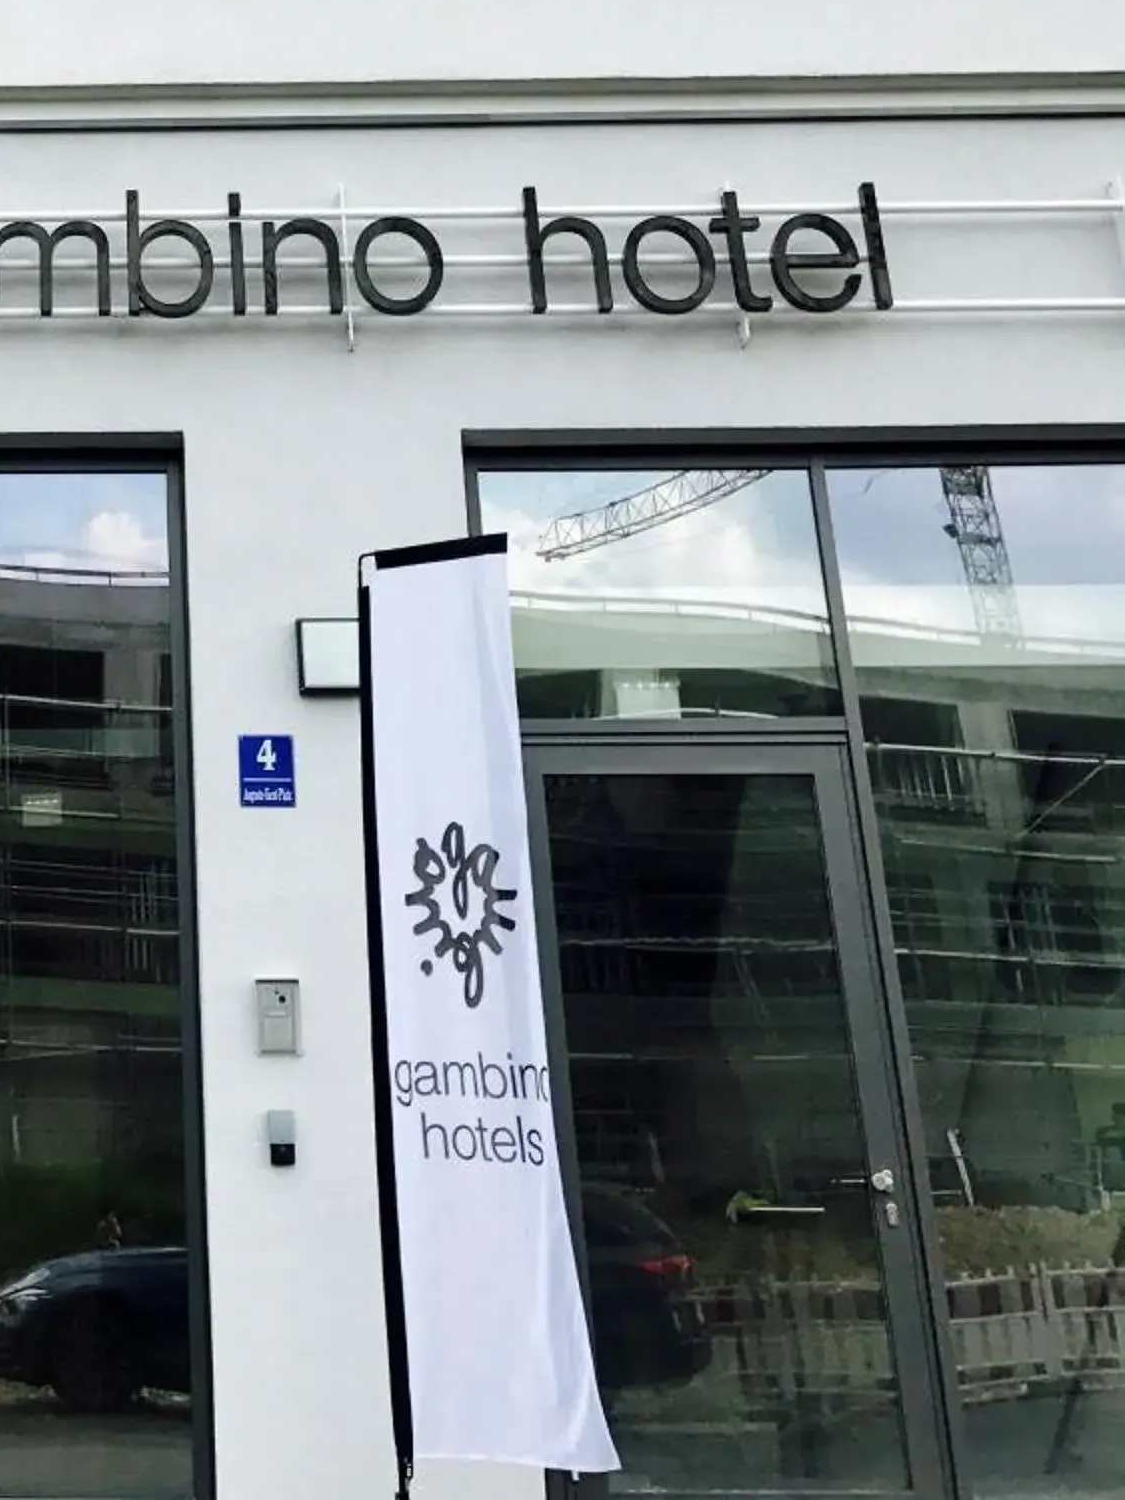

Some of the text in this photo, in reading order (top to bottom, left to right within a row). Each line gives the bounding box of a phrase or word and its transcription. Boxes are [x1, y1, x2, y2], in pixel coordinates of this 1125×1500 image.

[522, 182, 894, 314] hotel
[256, 739, 276, 771] 4
[421, 1112, 544, 1165] hotels
